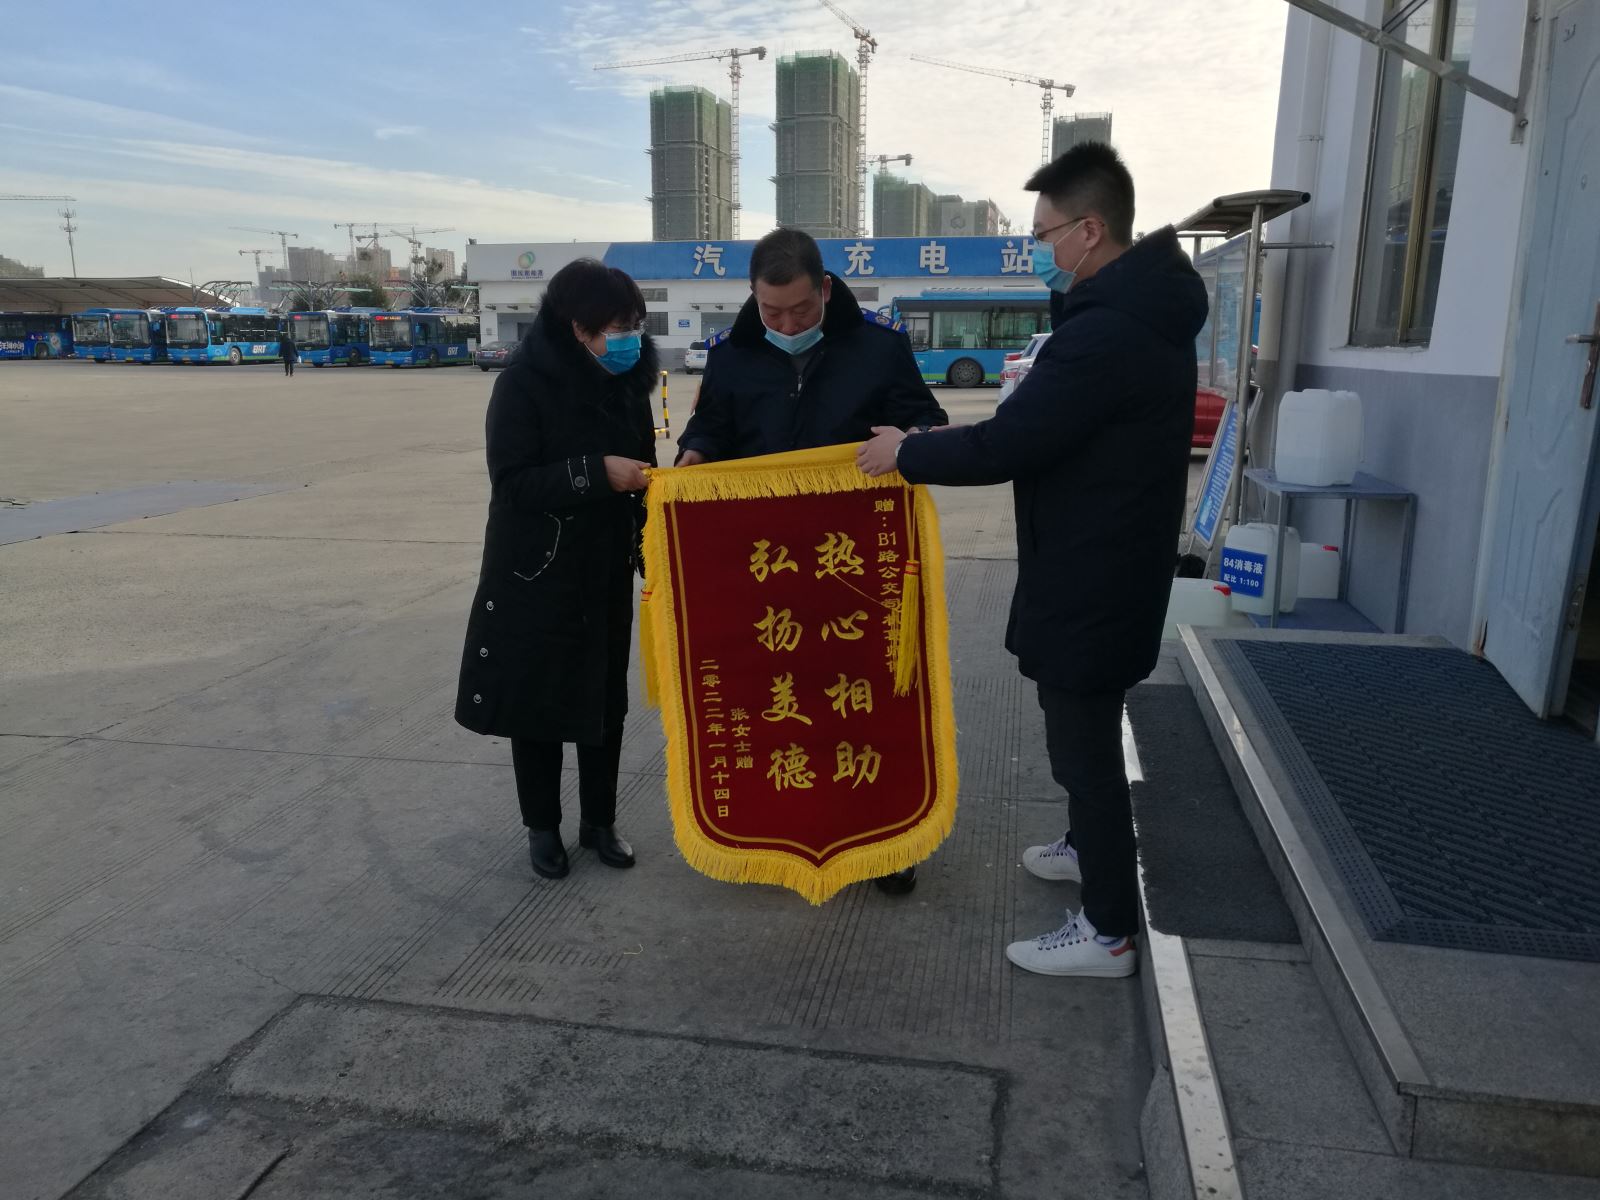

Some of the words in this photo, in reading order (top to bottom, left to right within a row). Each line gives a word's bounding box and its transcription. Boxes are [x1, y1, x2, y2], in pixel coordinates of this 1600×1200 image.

[252, 345, 266, 354] BRT
[447, 347, 459, 356] BRT
[1223, 557, 1264, 575] 84消毒液
[1223, 573, 1237, 583] 配比
[1239, 577, 1260, 588] 1:100
[749, 538, 817, 792] 弘扬美德
[814, 531, 882, 790] 热心相助
[699, 659, 730, 818] 二零二二年一月十四日
[730, 707, 754, 769] 张女士赠
